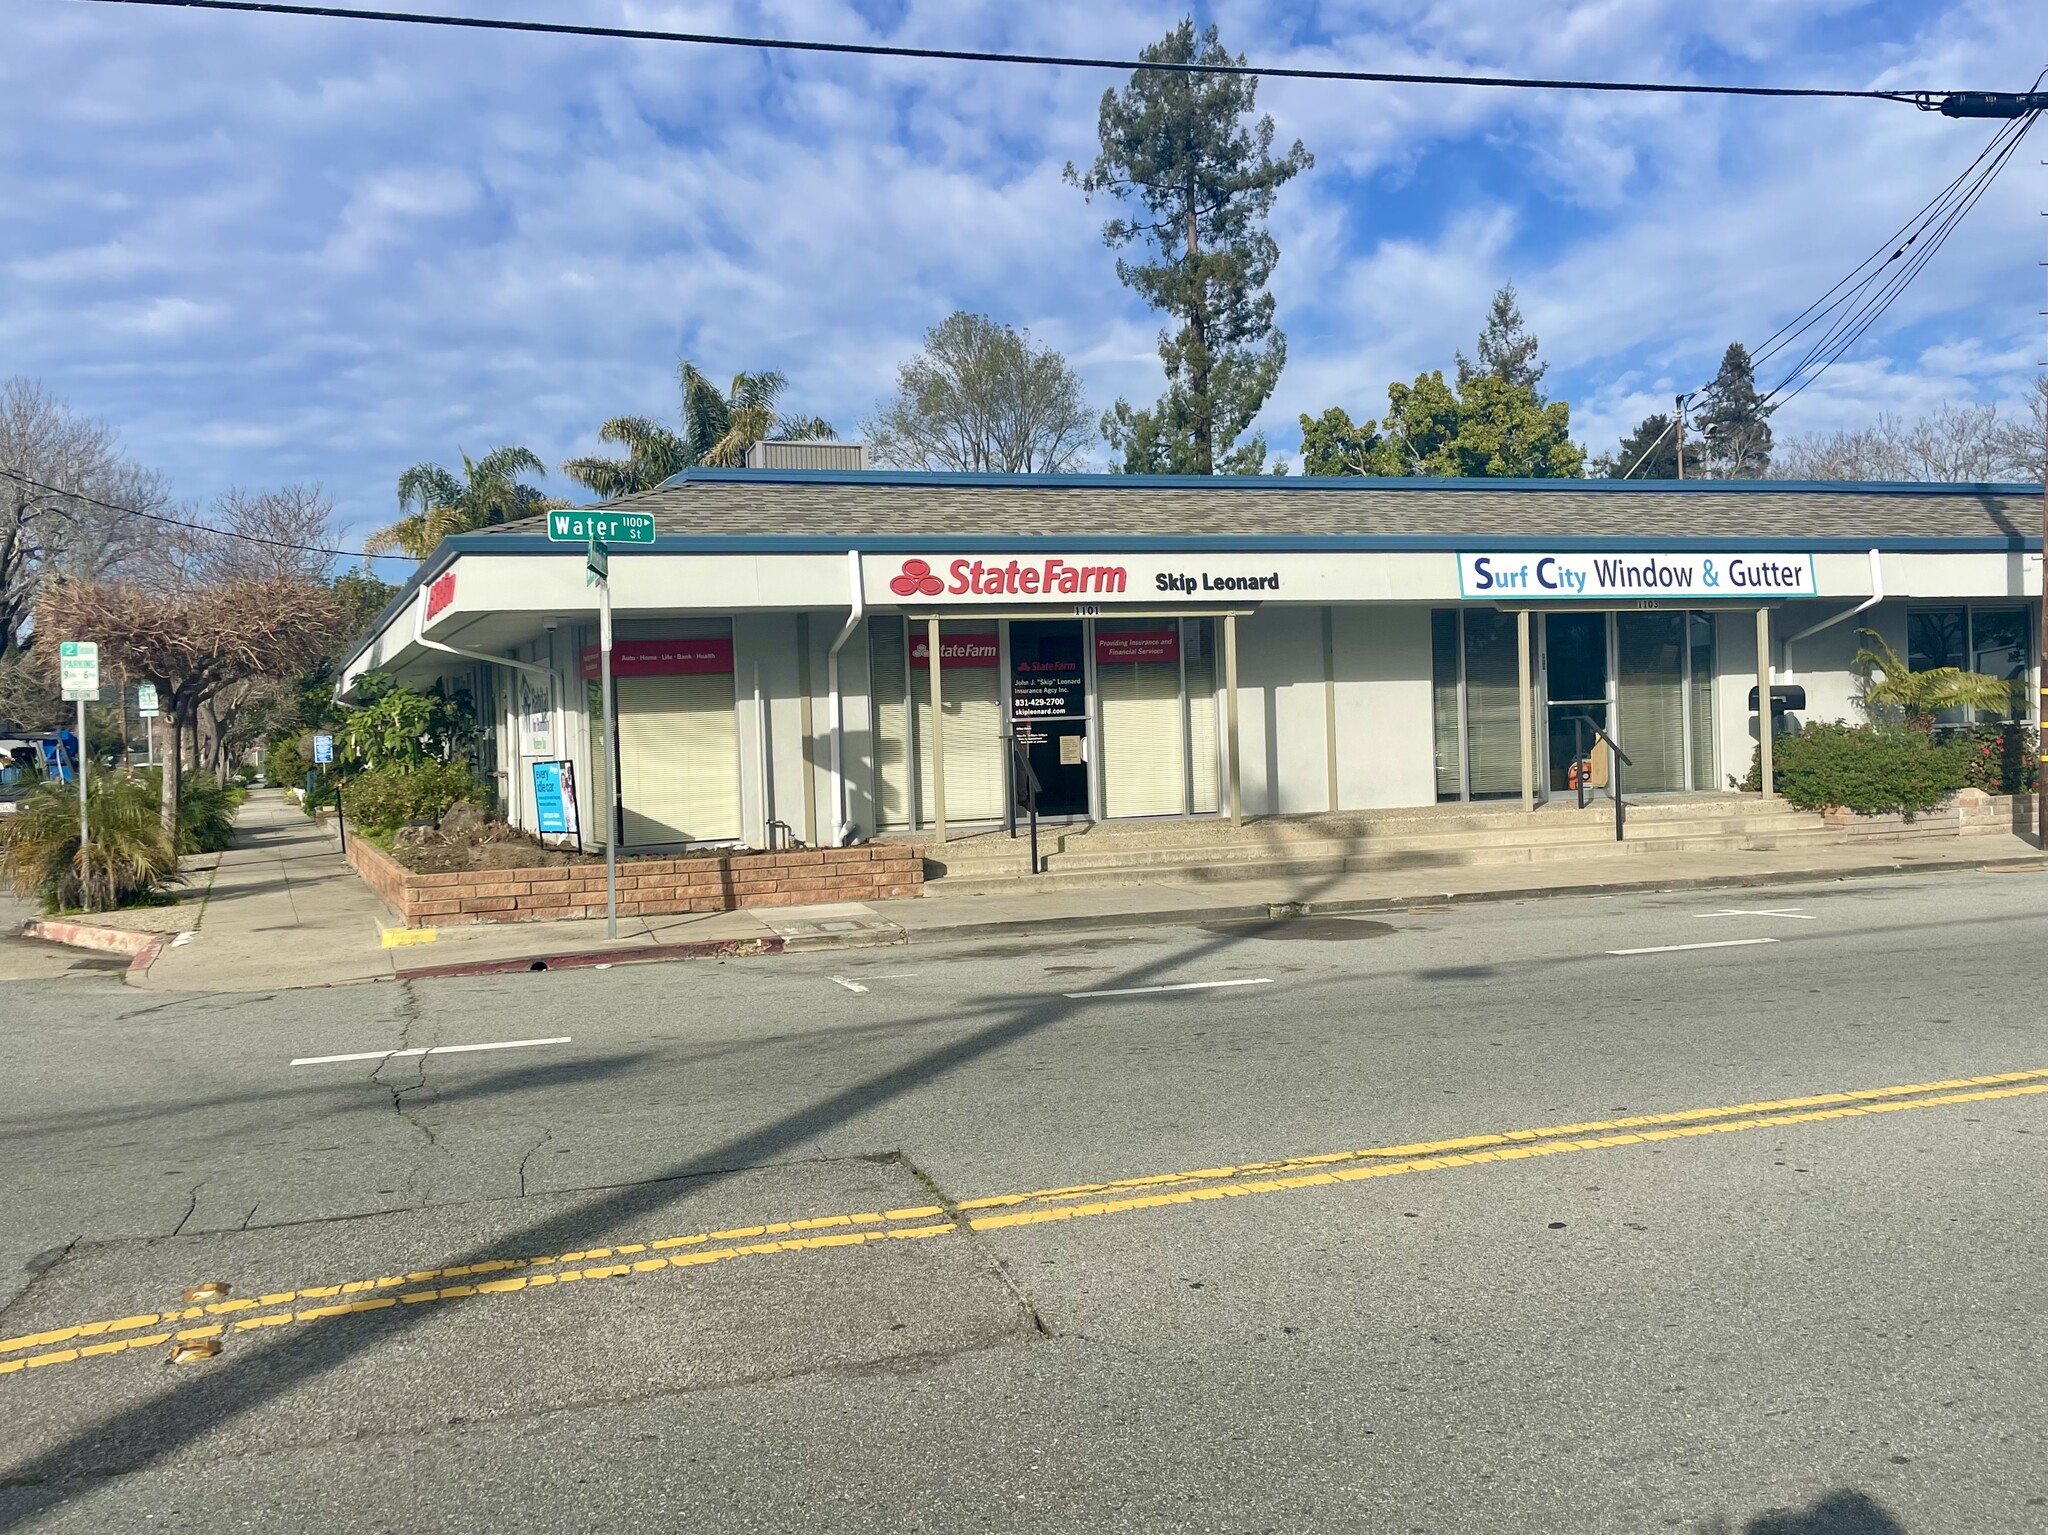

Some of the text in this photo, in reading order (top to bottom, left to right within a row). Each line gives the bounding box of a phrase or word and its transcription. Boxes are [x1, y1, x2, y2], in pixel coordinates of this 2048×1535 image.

[555, 516, 643, 536] Water 1100
[630, 529, 641, 539] St
[1475, 557, 1802, 593] Surf City Window & Gutter
[1155, 572, 1279, 594] Skip Leonard
[1638, 600, 1659, 609] 1103
[1075, 606, 1099, 616] 1101
[65, 645, 75, 656] 2
[1108, 647, 1164, 656] Financial Services
[1015, 698, 1065, 707] 831-429-2700
